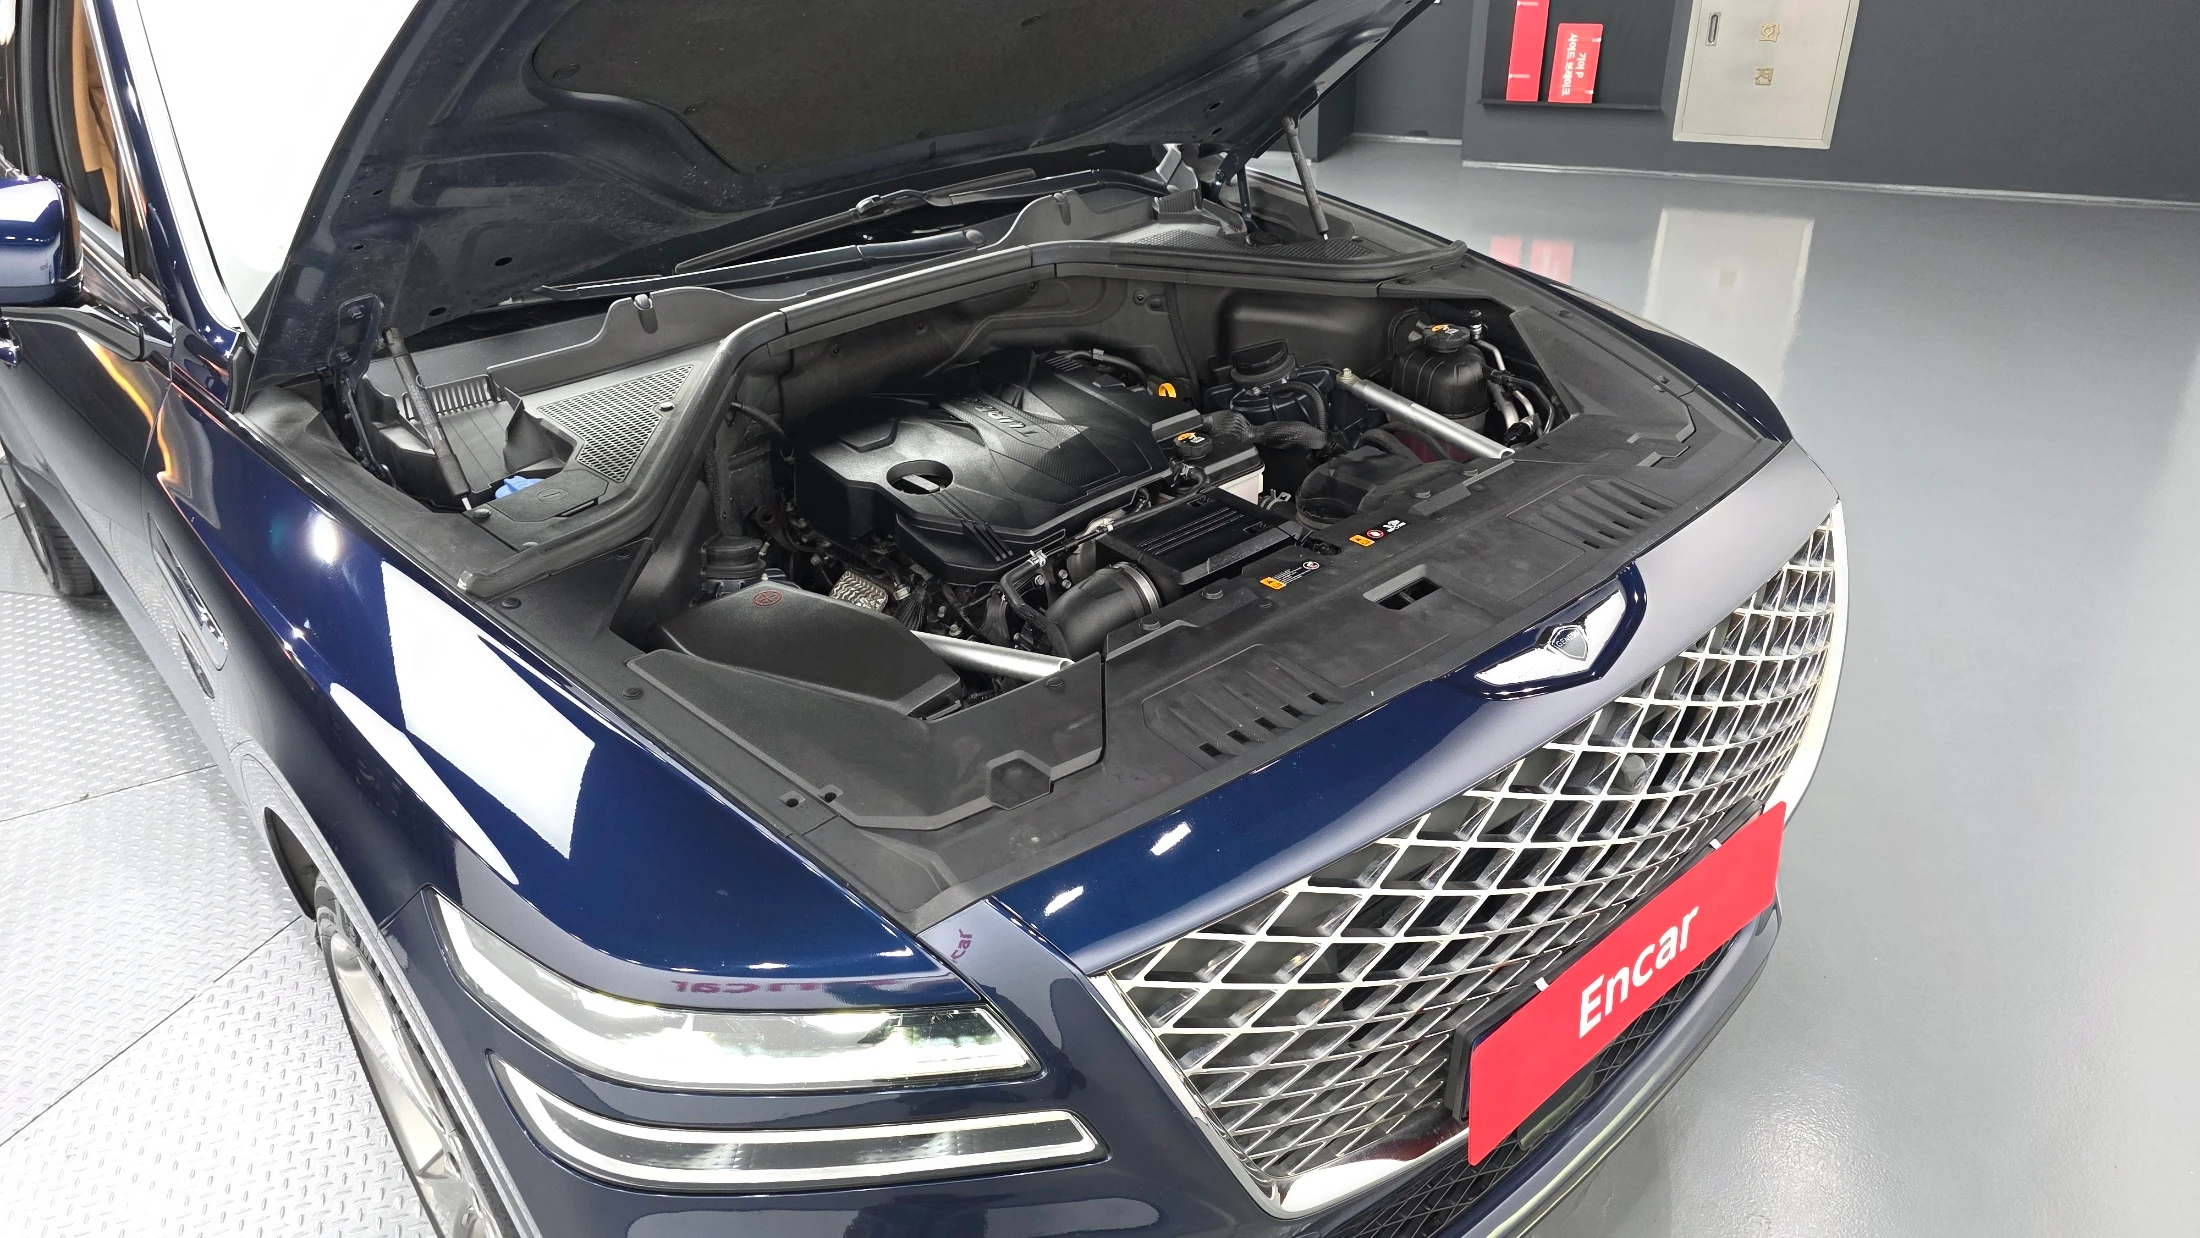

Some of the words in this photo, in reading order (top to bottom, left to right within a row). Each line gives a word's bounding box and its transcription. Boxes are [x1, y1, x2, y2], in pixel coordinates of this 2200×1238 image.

[1566, 33, 1578, 60] 사이드
[1575, 52, 1587, 70] 기어
[1561, 61, 1574, 96] 브레이크
[1575, 71, 1584, 79] P
[1555, 629, 1579, 648] GENES
[951, 929, 972, 963] car
[1579, 905, 1699, 1039] Encar
